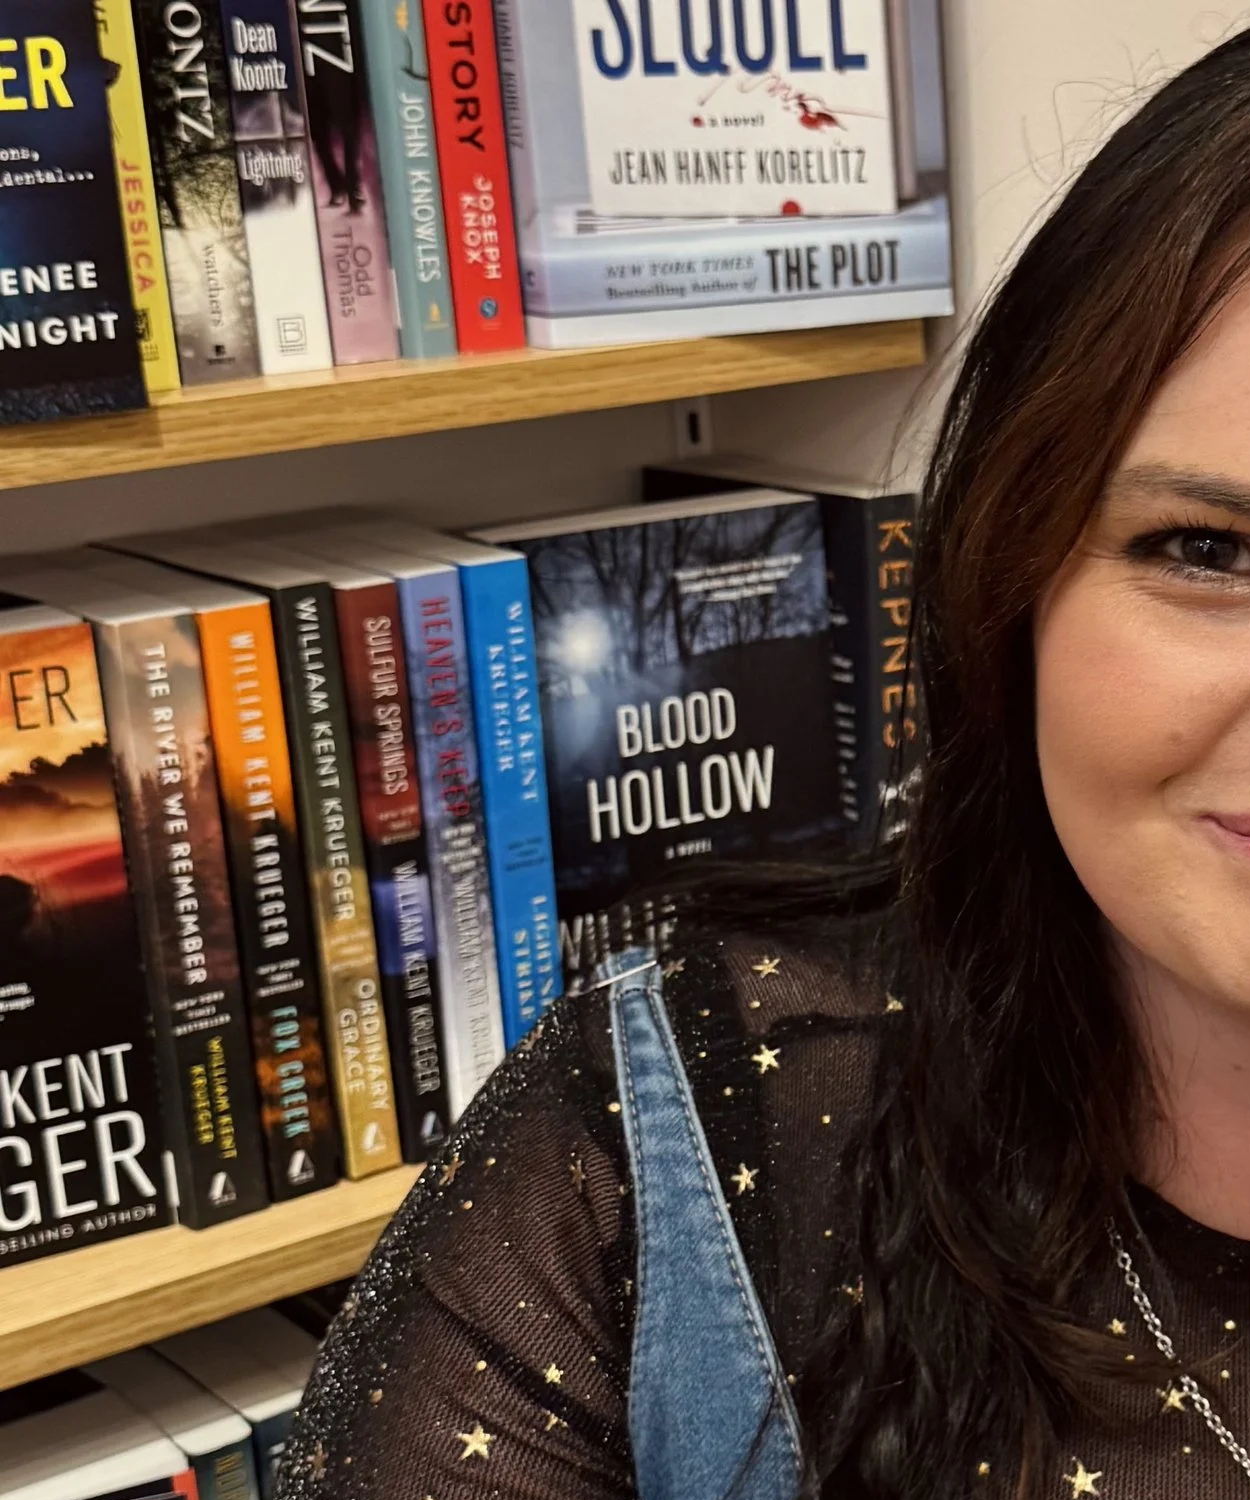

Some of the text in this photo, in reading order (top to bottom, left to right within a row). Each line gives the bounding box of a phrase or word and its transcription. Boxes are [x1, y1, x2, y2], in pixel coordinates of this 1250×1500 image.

[230, 17, 277, 54] Dean
[231, 57, 288, 91] Koontz
[445, 1, 485, 152] STORY
[238, 151, 304, 185] Lightning
[399, 92, 441, 283] JOHN KNOWLES
[609, 148, 868, 184] JEAN HANFF KORELITZ
[119, 158, 156, 293] JESSICA
[460, 193, 484, 264] KNOX
[473, 175, 502, 280] JOSEPH
[606, 255, 756, 279] NEW YORK TIMES
[764, 239, 900, 294] THE PLOT
[203, 243, 226, 328] watchers
[331, 227, 356, 317] Thomas
[352, 246, 373, 297] Odd
[692, 277, 738, 292] Author
[742, 276, 757, 291] of
[296, 596, 330, 714] WILLIAM
[363, 615, 399, 700] SULFUR
[419, 596, 464, 736] HEAVEN'S
[876, 520, 917, 749] KEPNES
[228, 631, 266, 744] WILLIAM
[616, 687, 737, 759] BLOOD
[243, 756, 276, 821] KENT
[310, 720, 341, 790] KENT
[373, 702, 410, 796] SPRINGS
[437, 748, 471, 817] KEEP
[516, 732, 538, 801] KENT
[143, 643, 208, 986] THE RIVER WE REMEMBER
[586, 745, 775, 844] HOLLOW
[252, 834, 289, 949] KRUEGER
[320, 796, 356, 922] KRUEGER
[392, 859, 425, 947] WILLIAM
[454, 877, 482, 960] WILLIAM
[404, 949, 432, 1000] KENT
[513, 928, 536, 1020] STRIKE
[269, 1005, 300, 1053] FOX
[338, 1008, 366, 1094] GRACE
[356, 978, 391, 1111] ORDINARY
[407, 1002, 441, 1096] KRUEGER
[0, 1042, 132, 1129] KENT
[276, 1060, 310, 1139] CREEK
